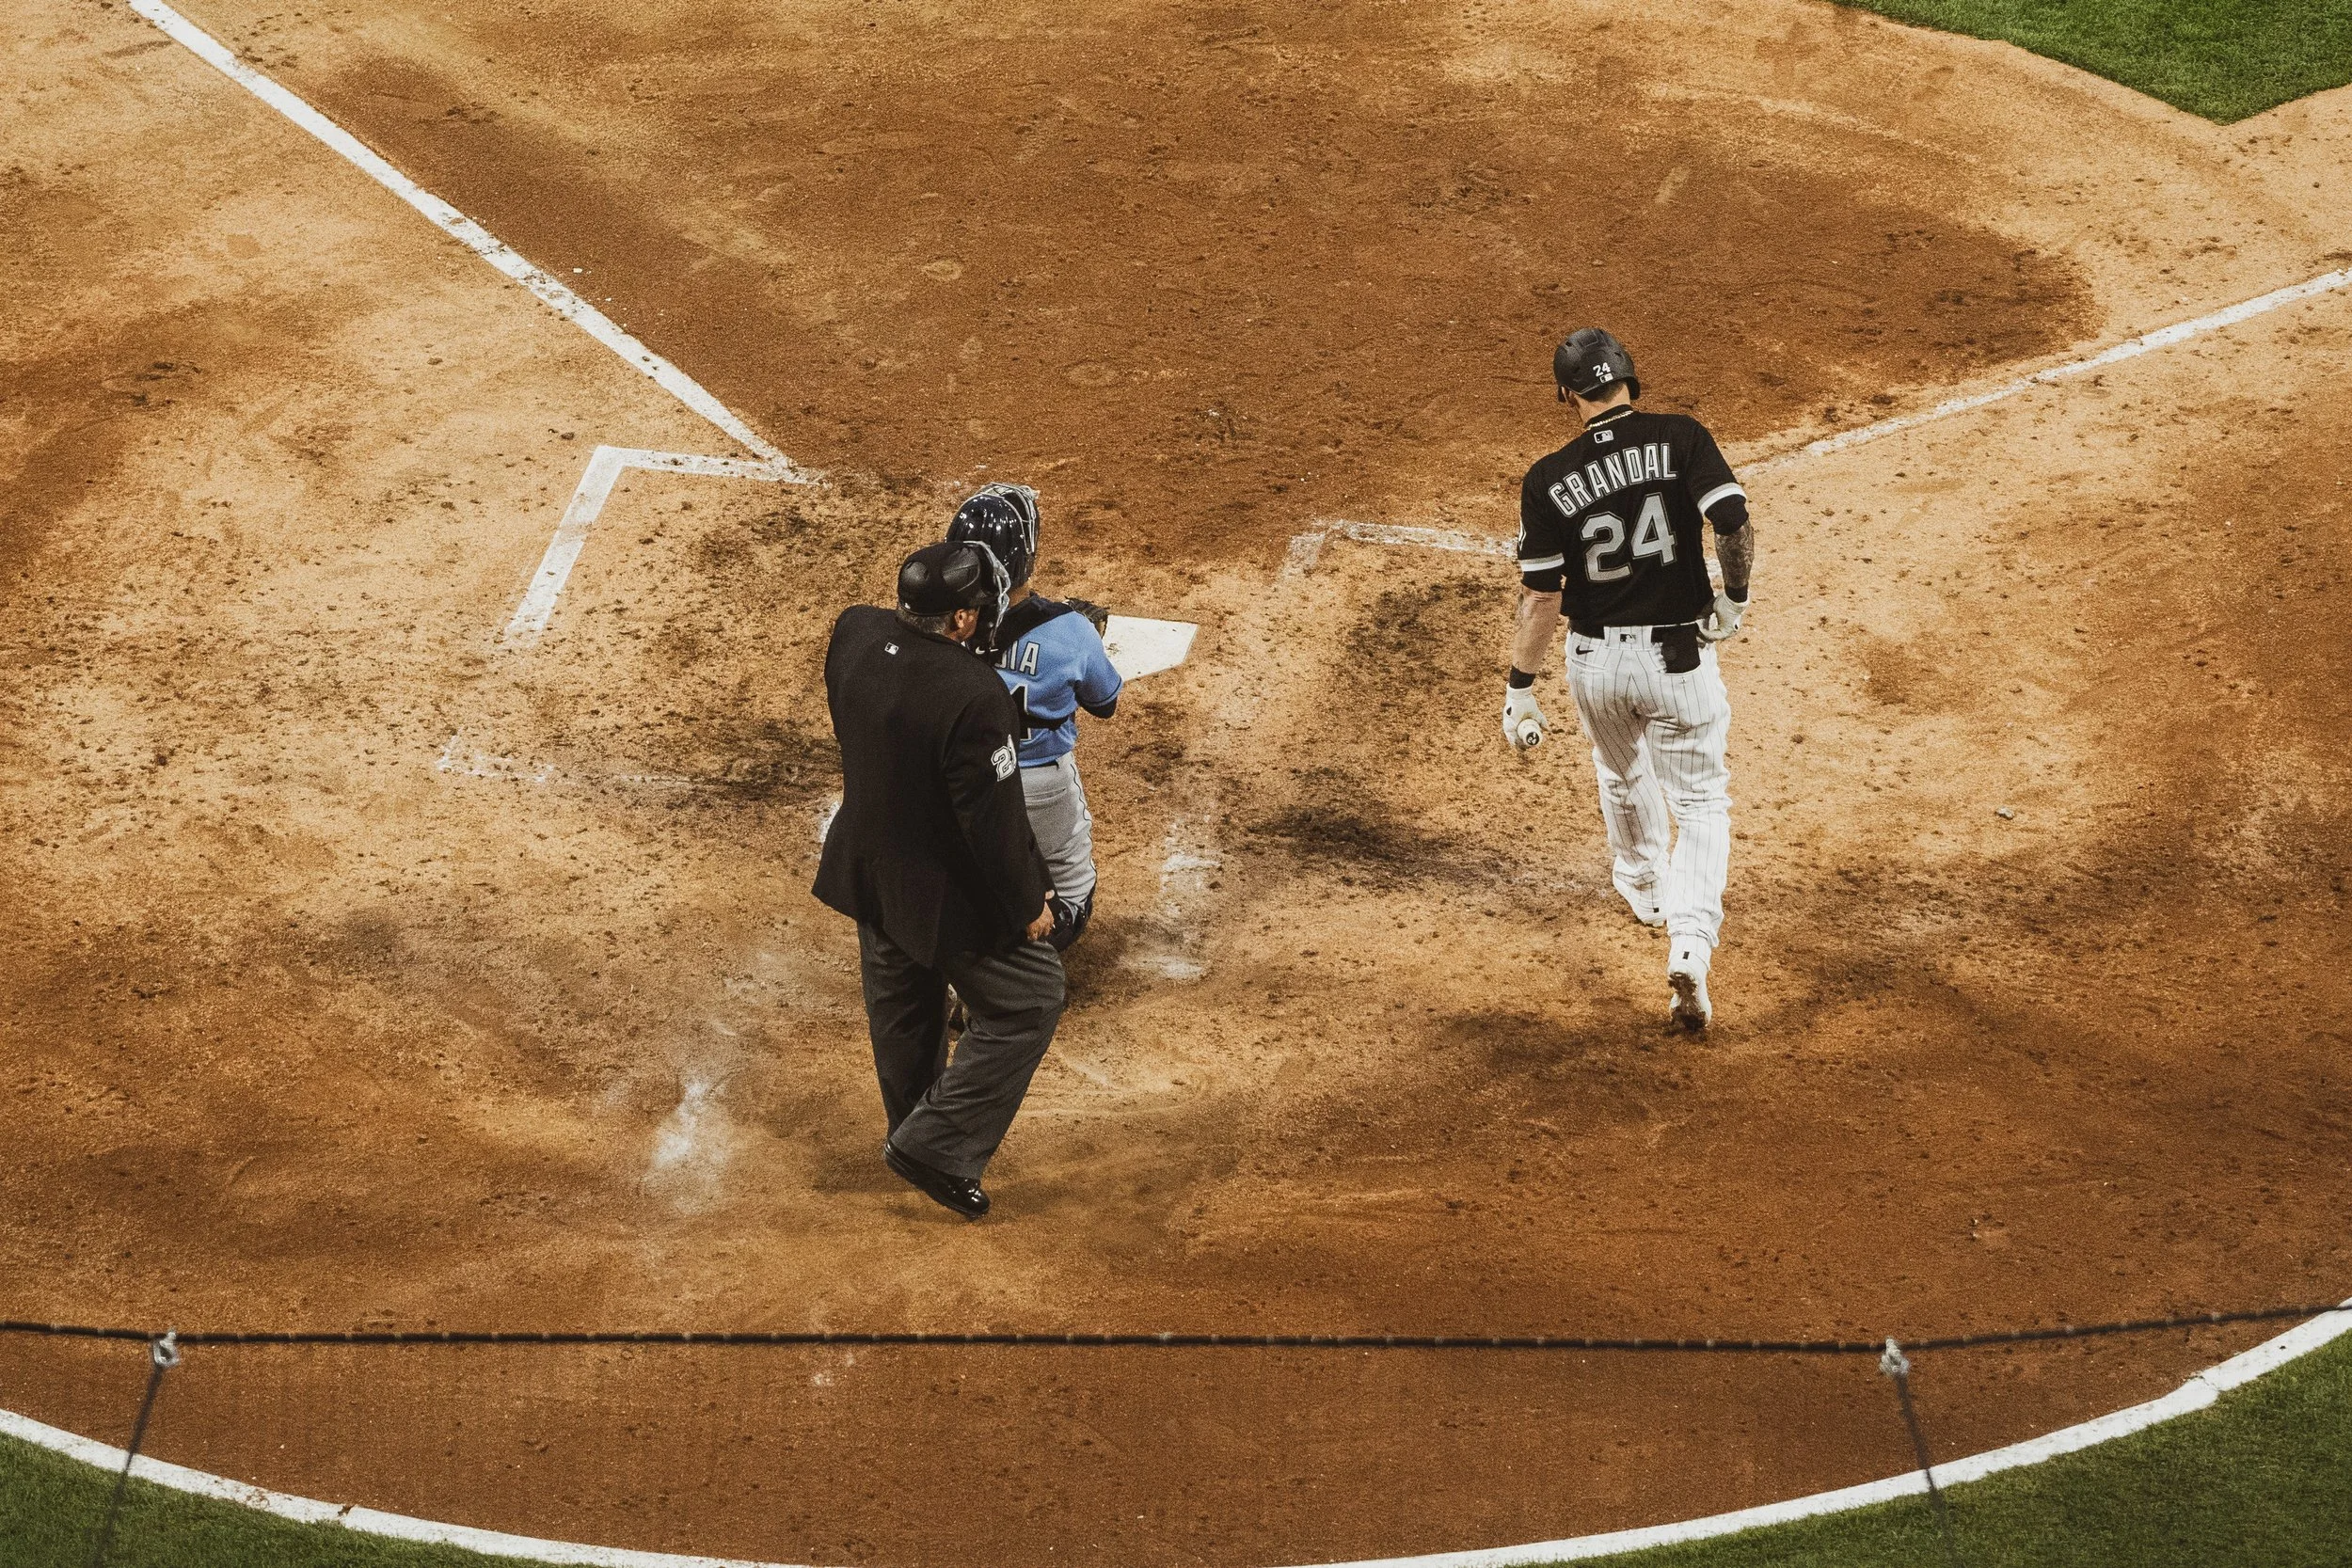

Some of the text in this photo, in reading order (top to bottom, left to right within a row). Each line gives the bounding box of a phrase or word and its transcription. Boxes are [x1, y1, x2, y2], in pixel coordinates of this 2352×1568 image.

[1593, 362, 1611, 376] 24
[1548, 443, 1677, 517] GRANDAL
[1580, 492, 1677, 582] 24
